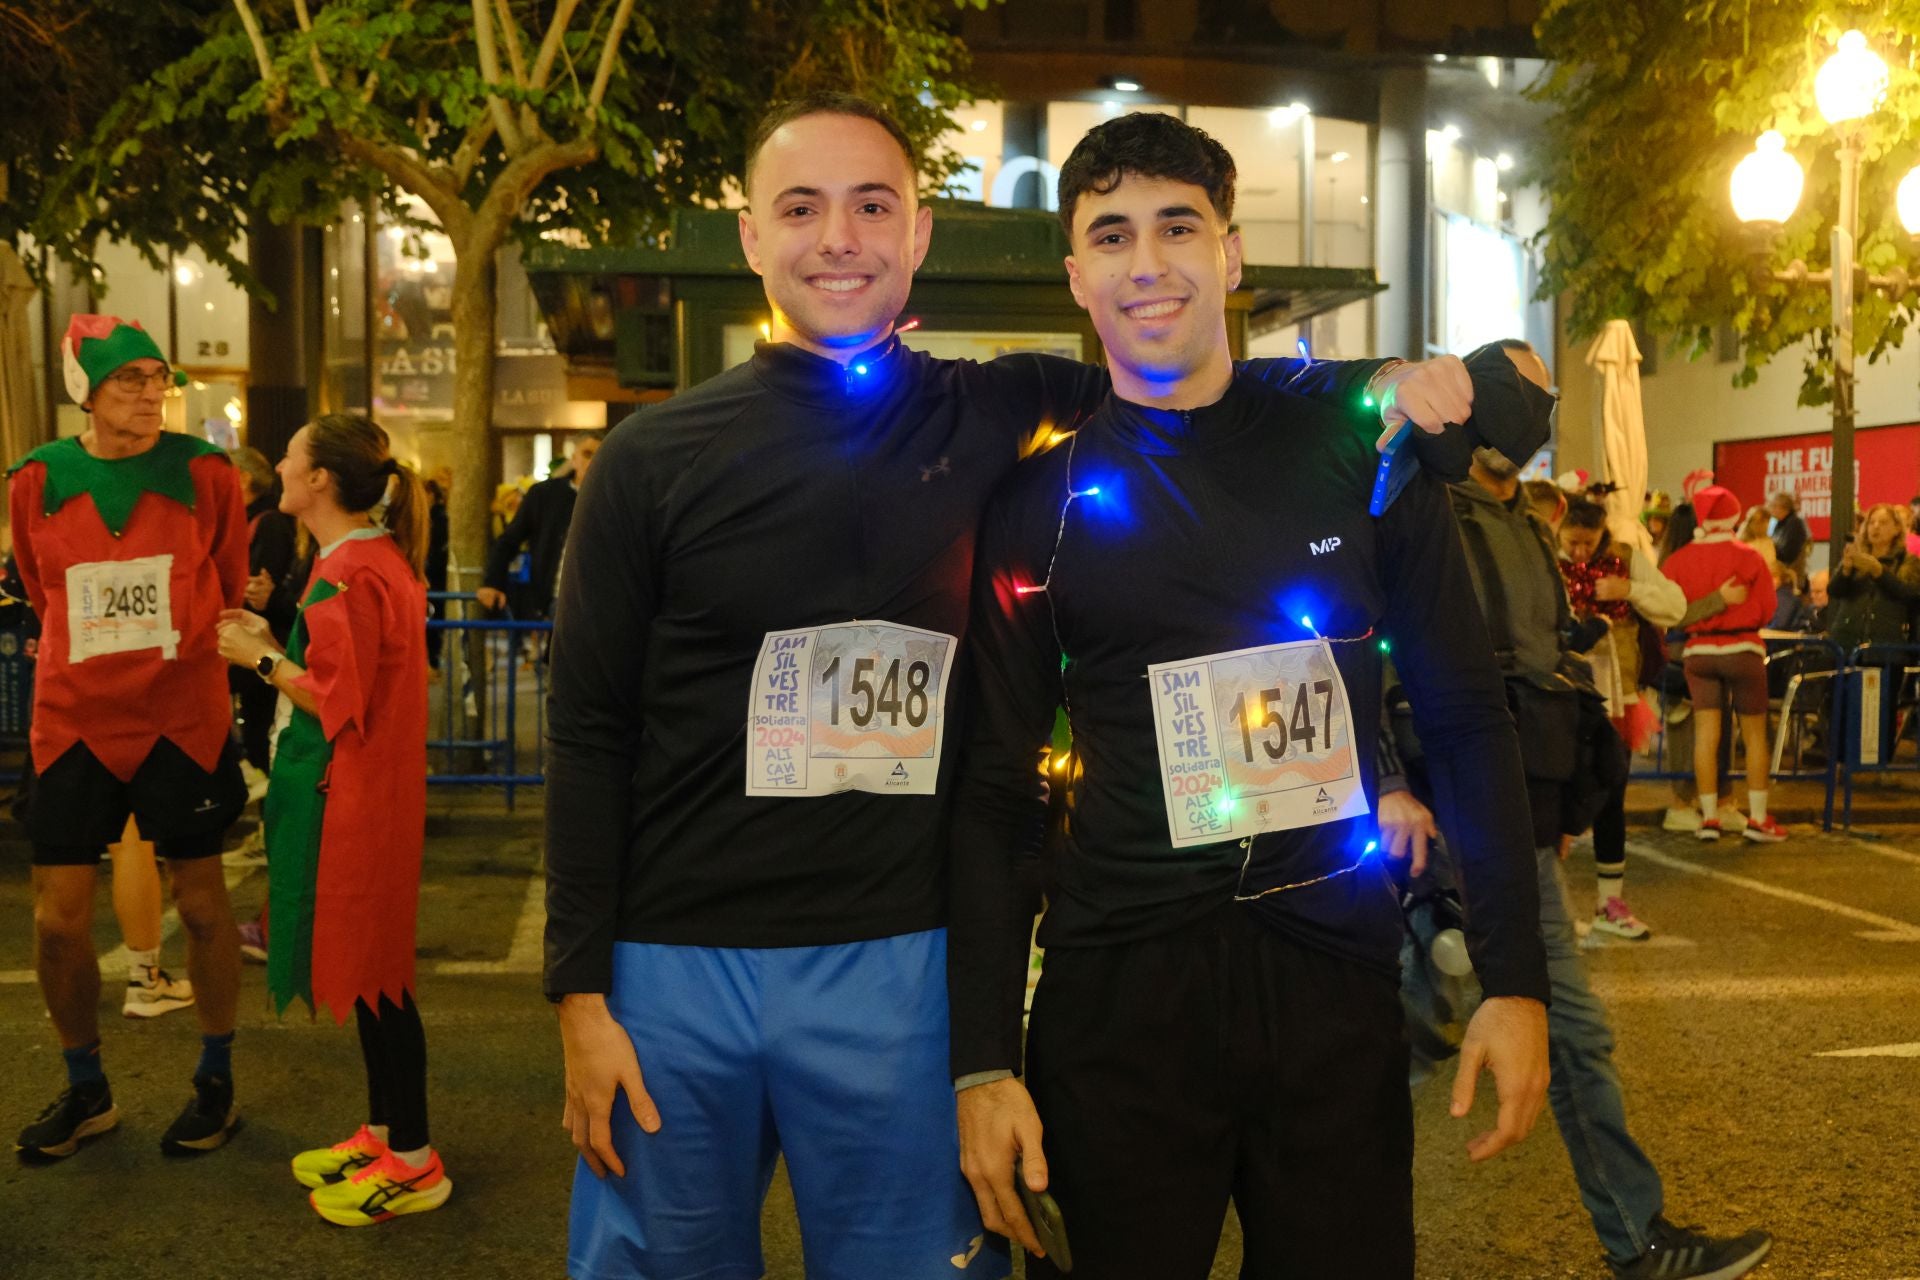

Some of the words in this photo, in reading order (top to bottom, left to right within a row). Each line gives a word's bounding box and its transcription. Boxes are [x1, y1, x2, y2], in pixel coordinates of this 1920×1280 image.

[1765, 449, 1803, 473] THE
[1808, 446, 1833, 470] FU
[103, 585, 157, 618] 2489
[770, 636, 808, 654] SAN
[768, 669, 800, 691] VES
[1162, 671, 1200, 695] SAN
[765, 692, 799, 713] TRE
[822, 656, 930, 728] 1548
[1172, 711, 1206, 736] VES
[1229, 679, 1333, 763] 1547
[755, 726, 805, 747] 2024
[1174, 735, 1211, 758] TRE
[765, 748, 792, 761] ALI
[767, 762, 795, 776] CAN
[1169, 758, 1221, 775] solidaria
[766, 774, 797, 786] TE
[1171, 772, 1224, 797] 2024
[1185, 793, 1213, 810] ALI
[1188, 807, 1218, 824] CAN
[1190, 819, 1223, 834] TE
